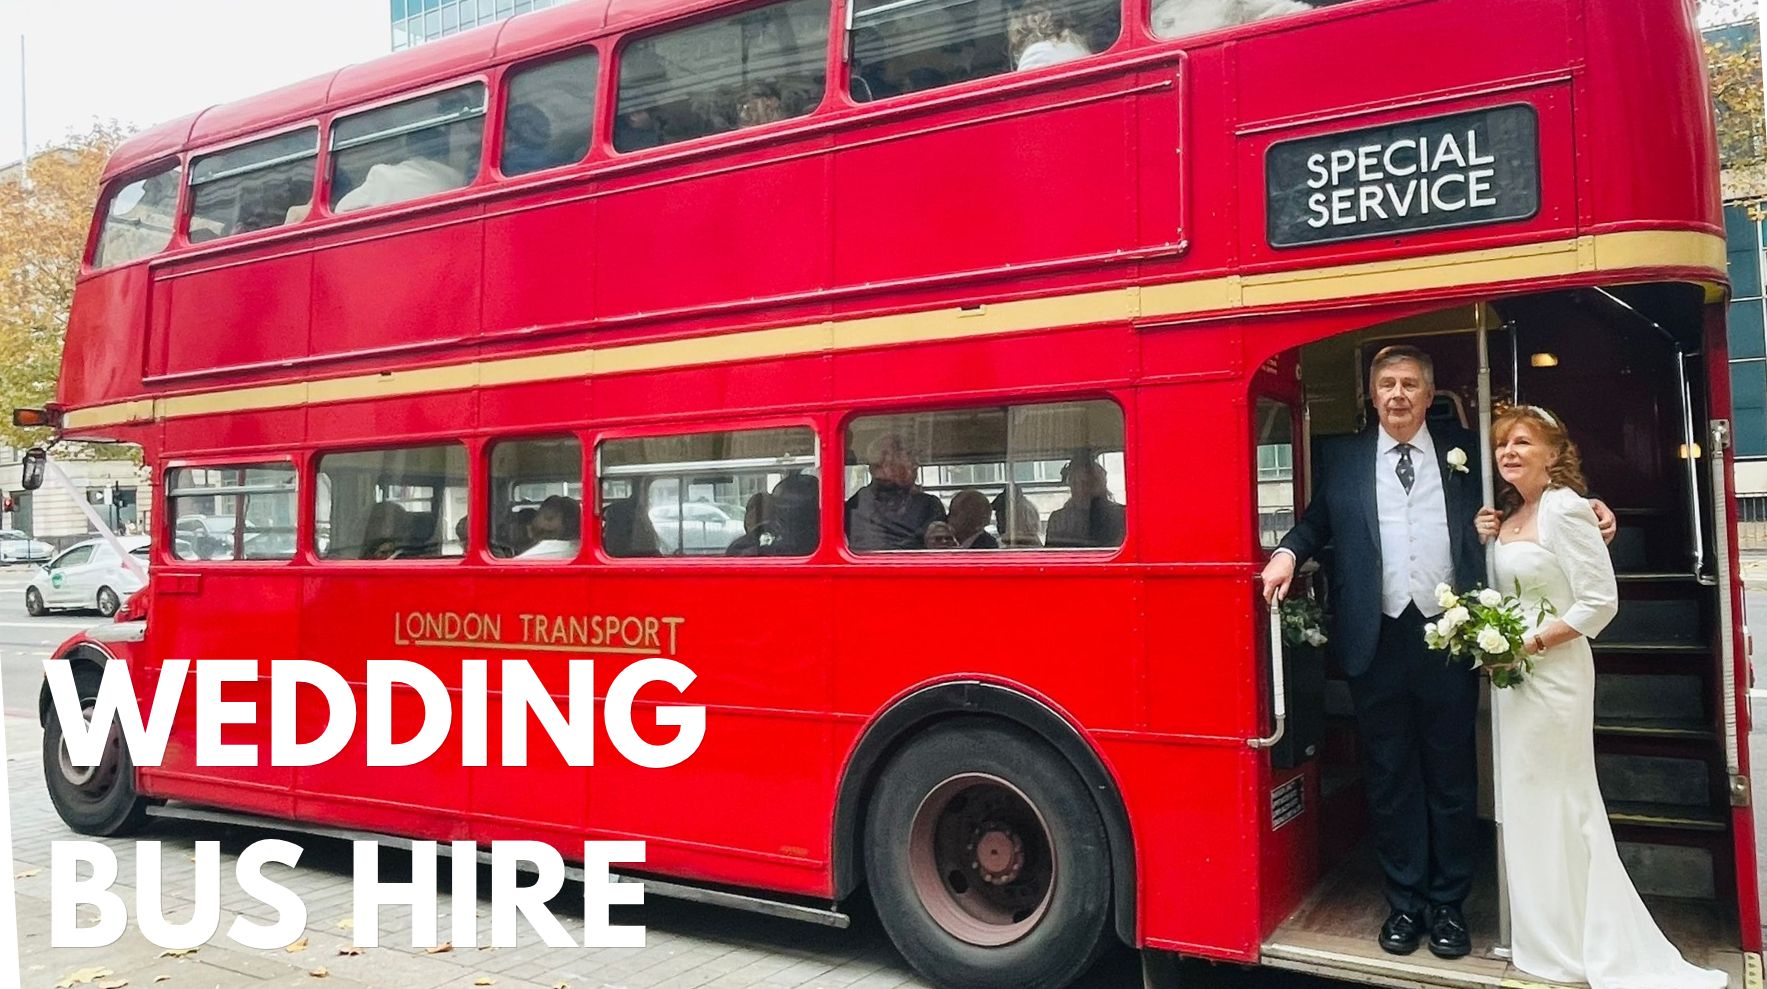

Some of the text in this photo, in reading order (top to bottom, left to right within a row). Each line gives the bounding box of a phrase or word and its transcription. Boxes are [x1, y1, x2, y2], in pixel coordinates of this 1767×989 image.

[1306, 129, 1495, 189] SPECIAL
[1307, 168, 1497, 228] SERVICE
[394, 612, 685, 656] LONDON TRANSPORT
